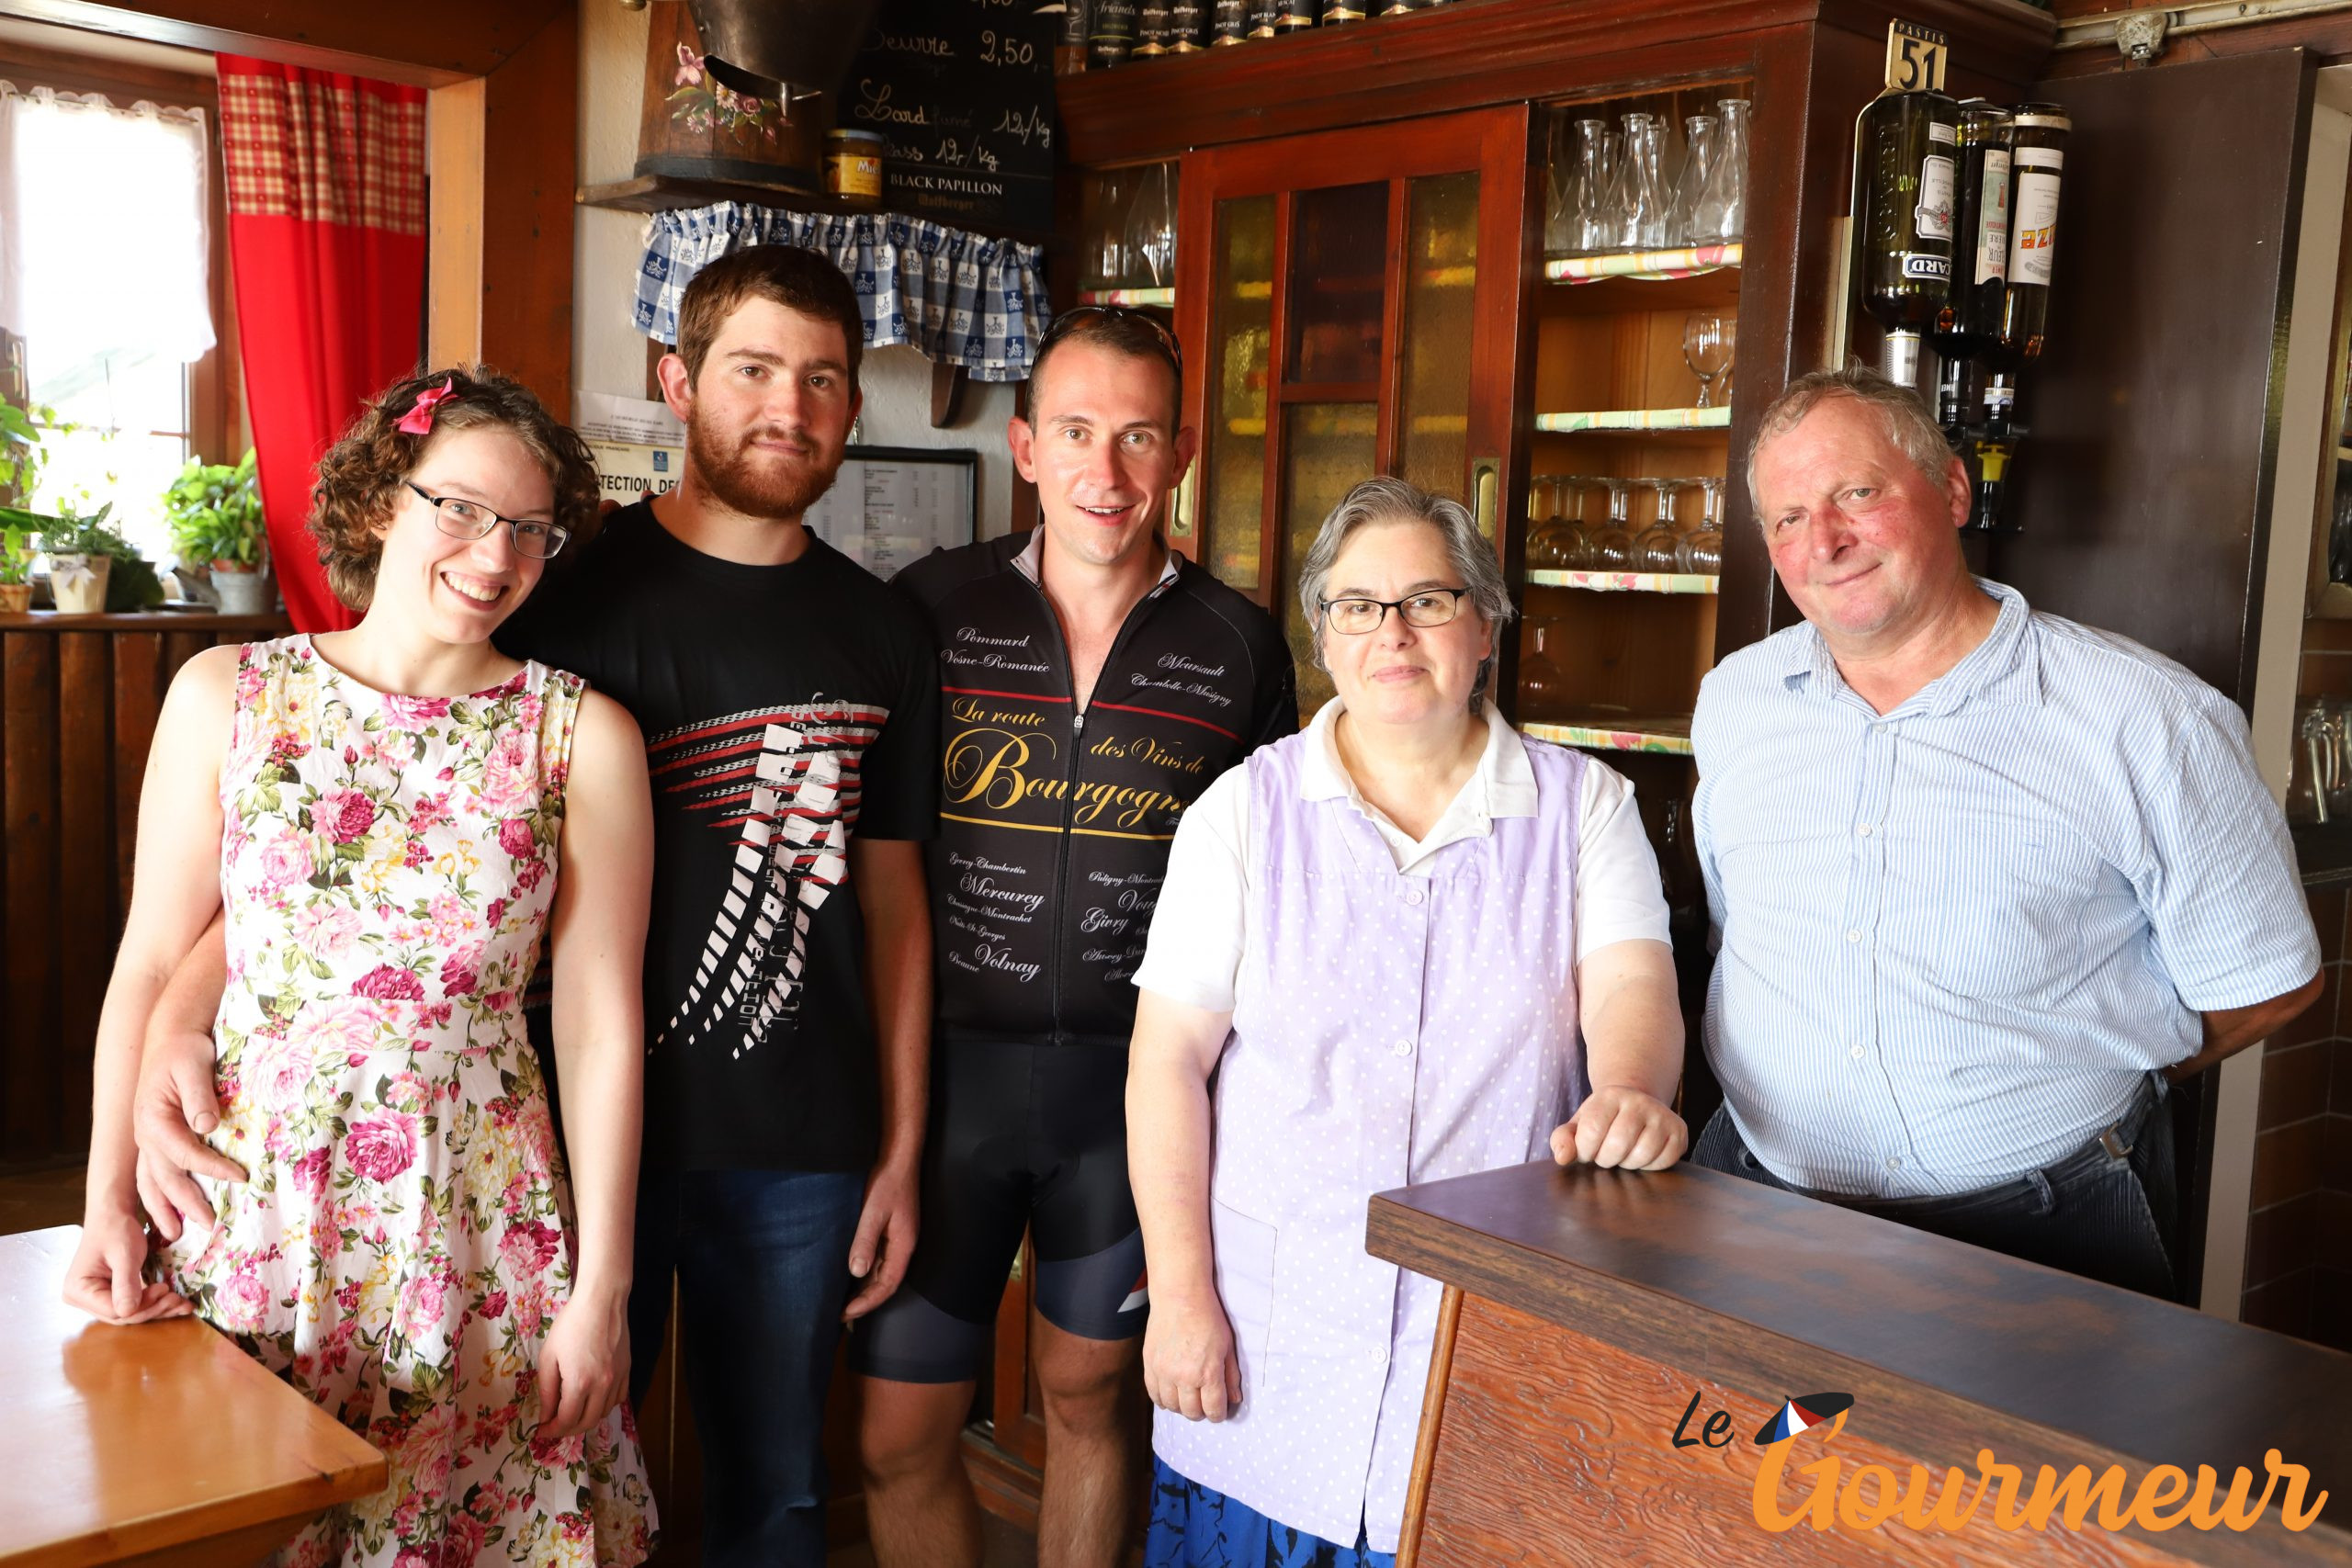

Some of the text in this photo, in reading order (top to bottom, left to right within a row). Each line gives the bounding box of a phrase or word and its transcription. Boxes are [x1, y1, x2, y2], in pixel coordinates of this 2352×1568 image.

[1898, 23, 1945, 45] PASTIS
[1898, 38, 1937, 90] 51
[890, 172, 934, 189] BLACK
[937, 177, 1002, 196] PAPILLON
[597, 475, 651, 492] TECTION
[956, 626, 1031, 647] Pommard
[940, 649, 1049, 672] Vosne-Romanée
[1158, 653, 1226, 677] Meursault
[1131, 673, 1232, 707] Chambolle-Musigny
[952, 697, 1046, 727] La route
[1091, 737, 1205, 774] des Vins de
[960, 873, 1046, 912] Mercurey
[1080, 907, 1130, 935] Givry
[948, 951, 980, 973] Beaune
[974, 943, 1042, 983] Volnay
